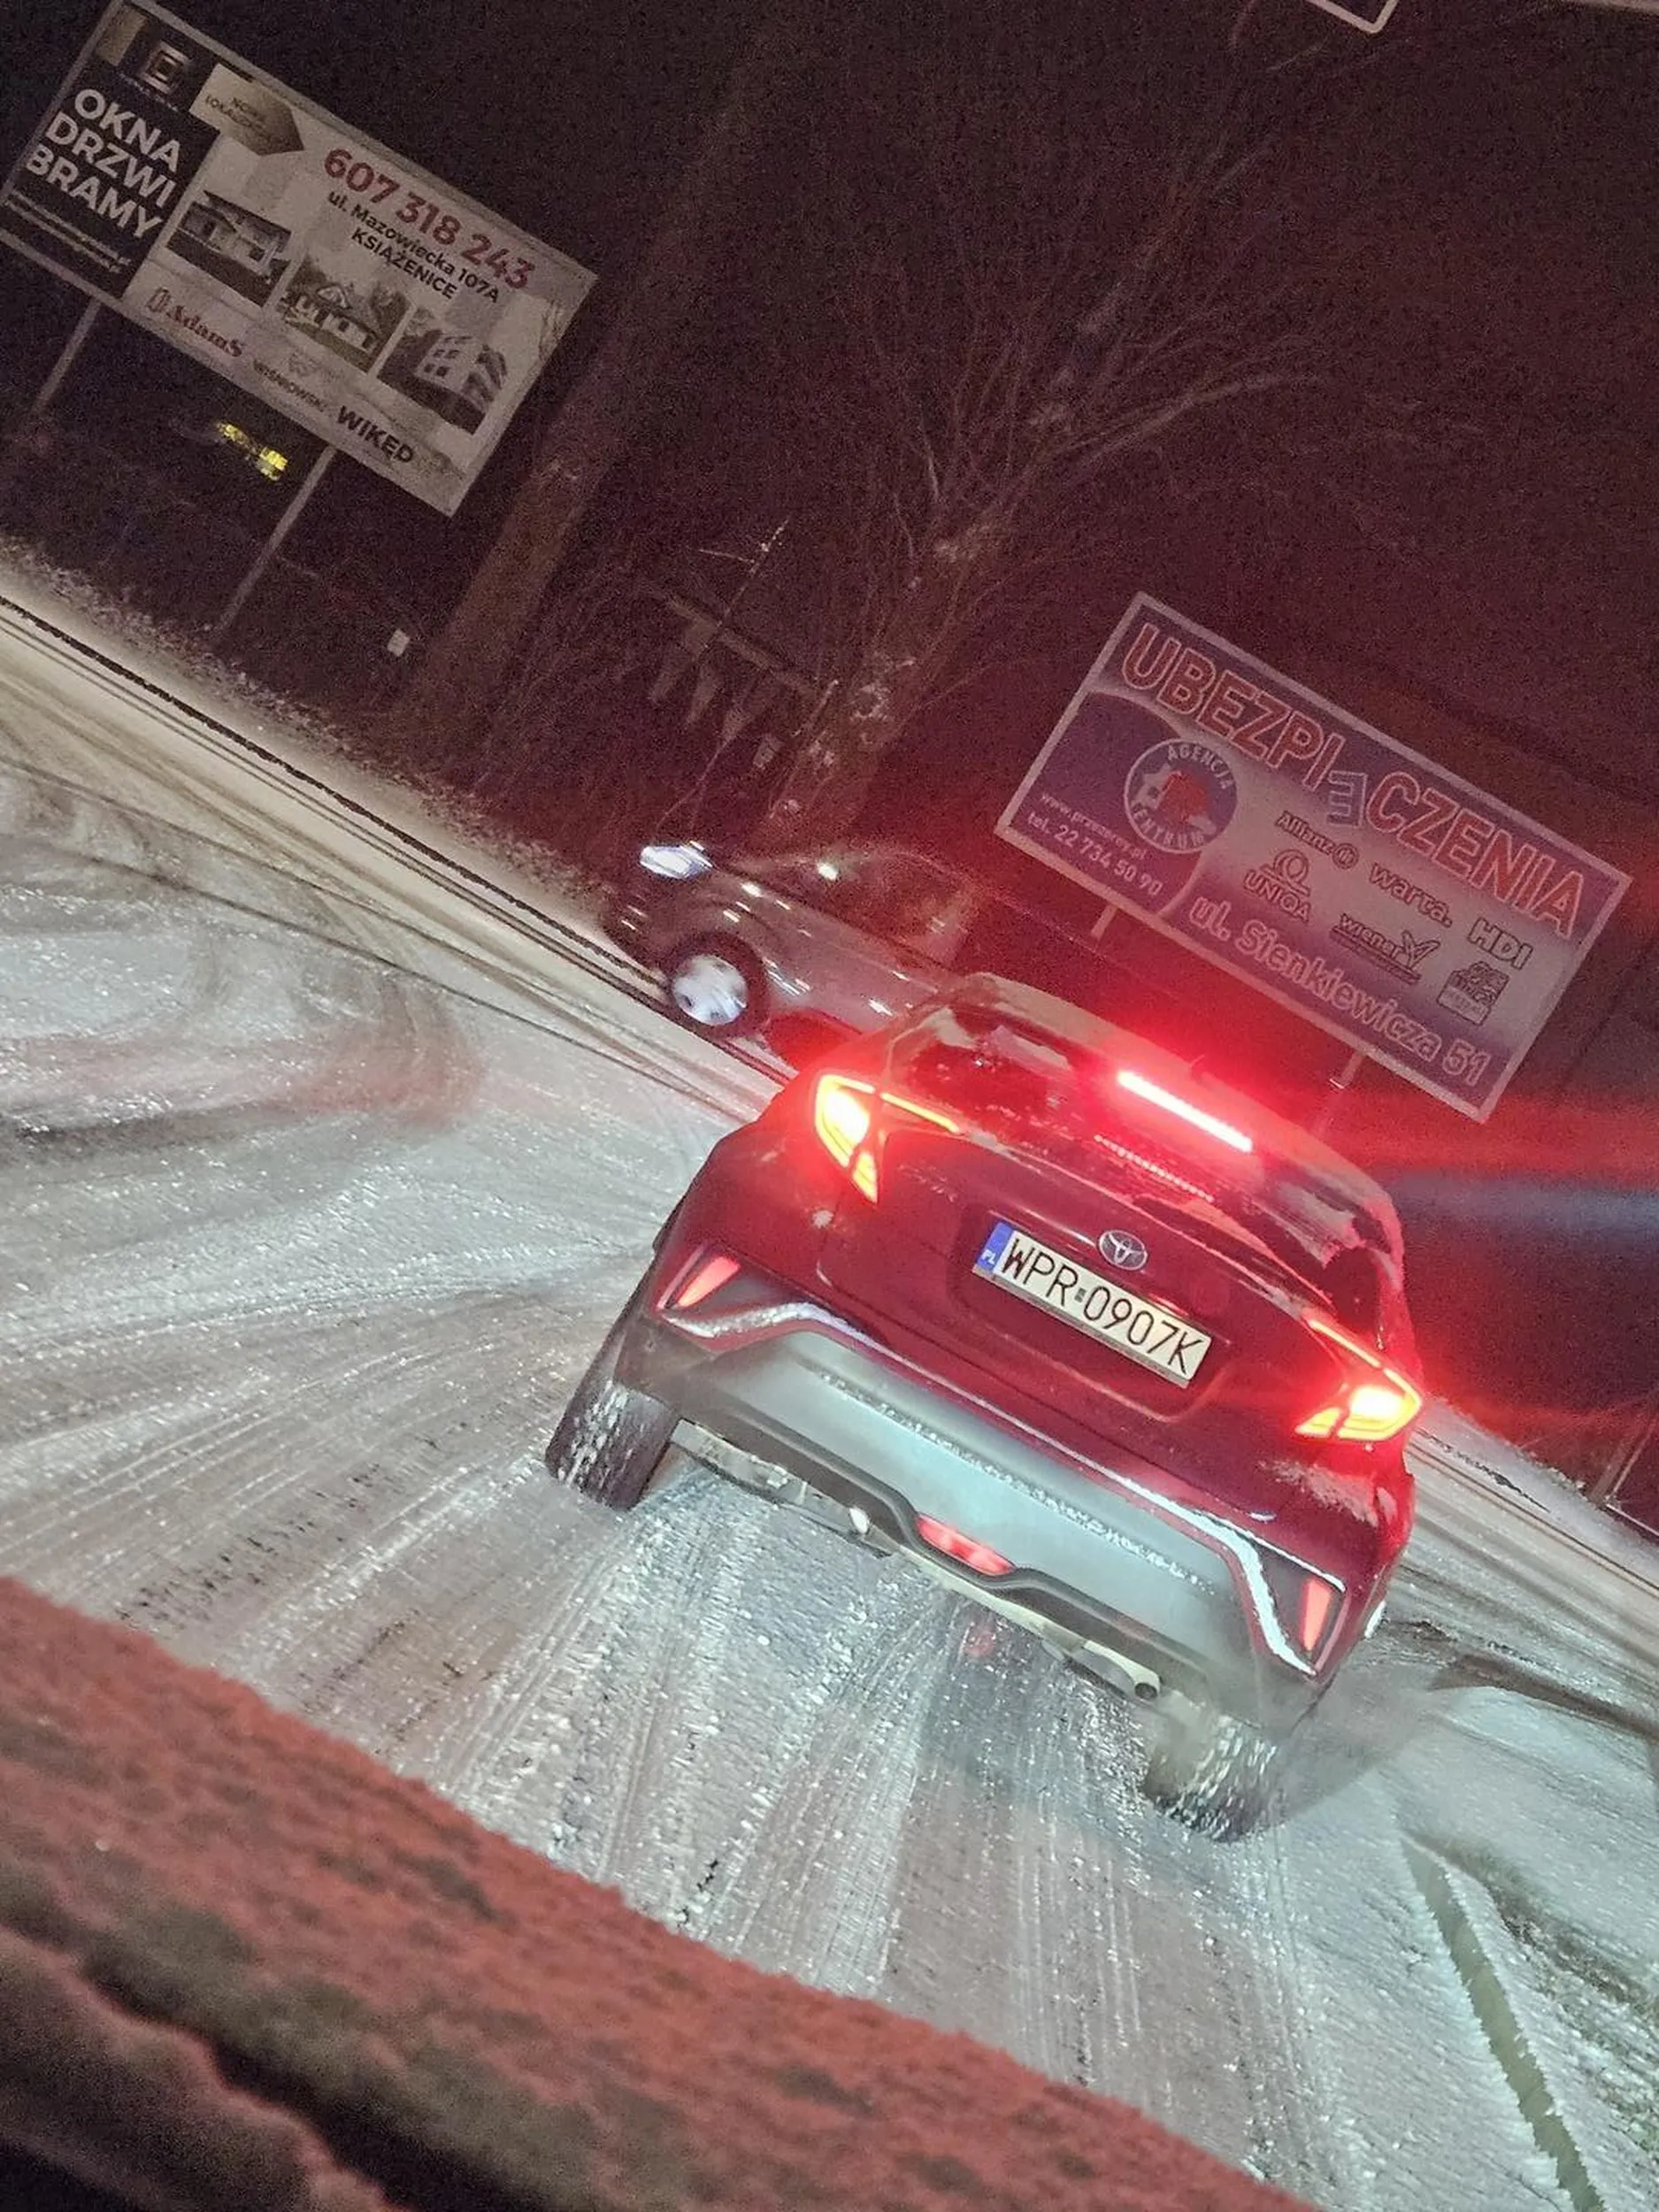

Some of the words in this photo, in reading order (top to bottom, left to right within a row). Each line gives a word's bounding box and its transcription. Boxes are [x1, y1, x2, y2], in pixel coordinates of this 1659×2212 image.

[46, 111, 176, 208] DRZWI
[74, 88, 180, 173] OKNA
[26, 143, 163, 237] BRAMY
[324, 149, 400, 204] 607
[396, 191, 461, 245] 318
[460, 233, 535, 289] 243
[328, 191, 346, 212] ul.
[351, 204, 456, 274] Mazowiecka
[454, 268, 499, 303] 107A
[351, 227, 457, 299] KSIĄŻENICE
[337, 405, 413, 463] WIKĘD
[1027, 812, 1050, 834] tel.
[1054, 824, 1079, 848] 22
[1079, 840, 1111, 868] 734
[1113, 859, 1138, 883] 50
[1138, 872, 1164, 896] 90
[1274, 810, 1337, 856] Allianz
[1242, 868, 1312, 924] UNIQA
[1466, 918, 1534, 971] HDI
[1188, 895, 1231, 942] ul.
[1234, 919, 1443, 1063] Sienkiewicza
[1441, 1037, 1493, 1087] 51
[980, 1249, 996, 1265] PL
[1001, 1238, 1079, 1307] WPR
[1082, 1285, 1205, 1375] 0907K
